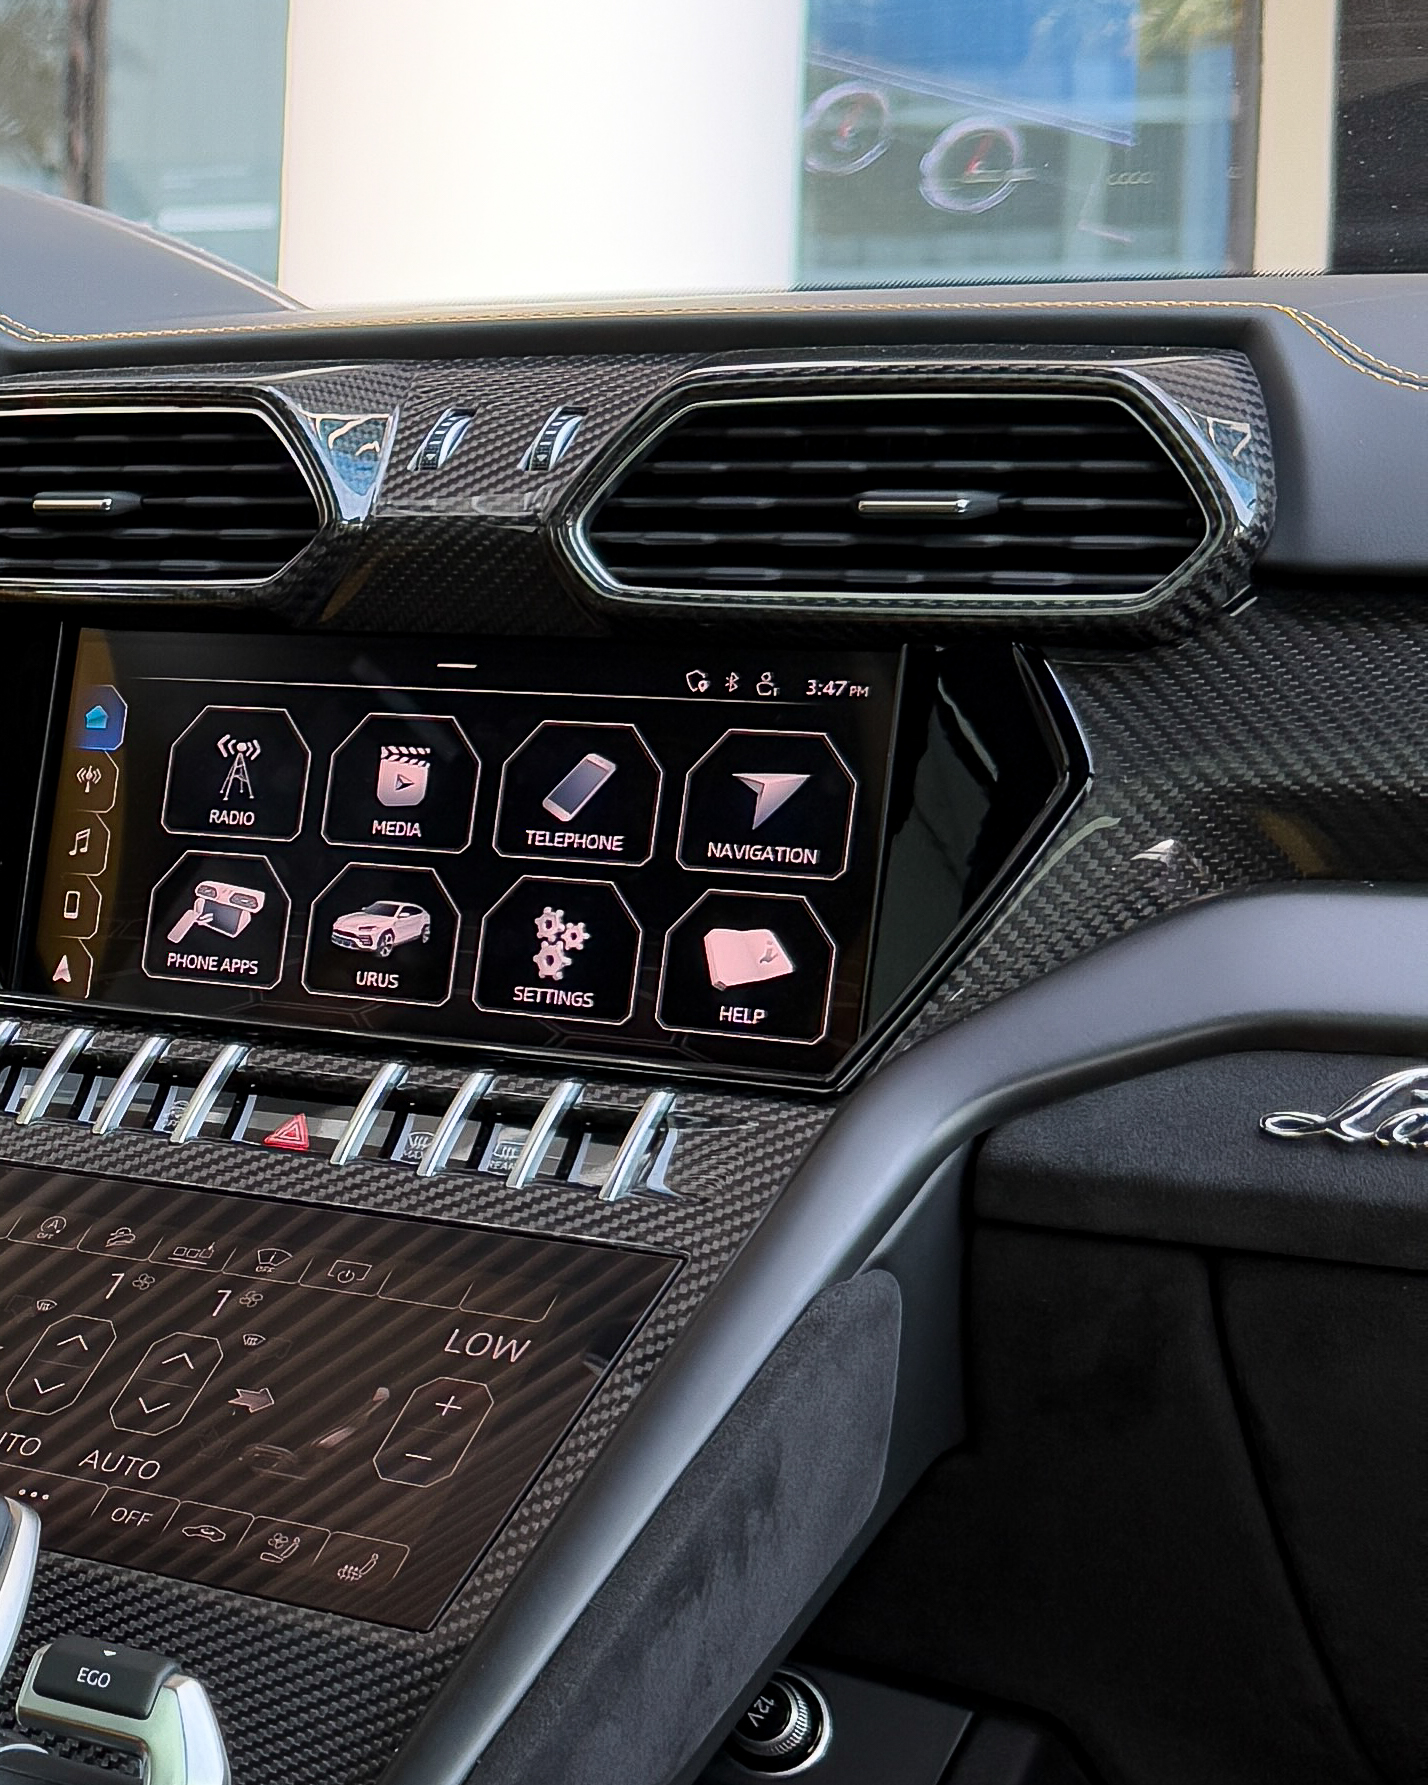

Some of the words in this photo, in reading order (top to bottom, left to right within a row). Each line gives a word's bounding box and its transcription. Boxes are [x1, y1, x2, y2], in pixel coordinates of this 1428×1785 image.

[805, 679, 848, 696] 3:47
[849, 685, 870, 697] PM
[209, 809, 255, 826] RADIO
[372, 819, 422, 838] MEDIA
[525, 829, 625, 852] TELEPHONE
[707, 841, 820, 865] NAVIGATION
[166, 952, 218, 972] PHONE
[219, 957, 259, 975] APPS
[355, 971, 400, 989] URUS
[512, 986, 595, 1009] SETTINGS
[719, 1005, 768, 1025] HELP
[443, 1328, 531, 1363] LOW
[78, 1449, 162, 1480] AUTO
[110, 1507, 155, 1527] OFF
[76, 1667, 112, 1688] EGO
[747, 1695, 775, 1728] 12V
